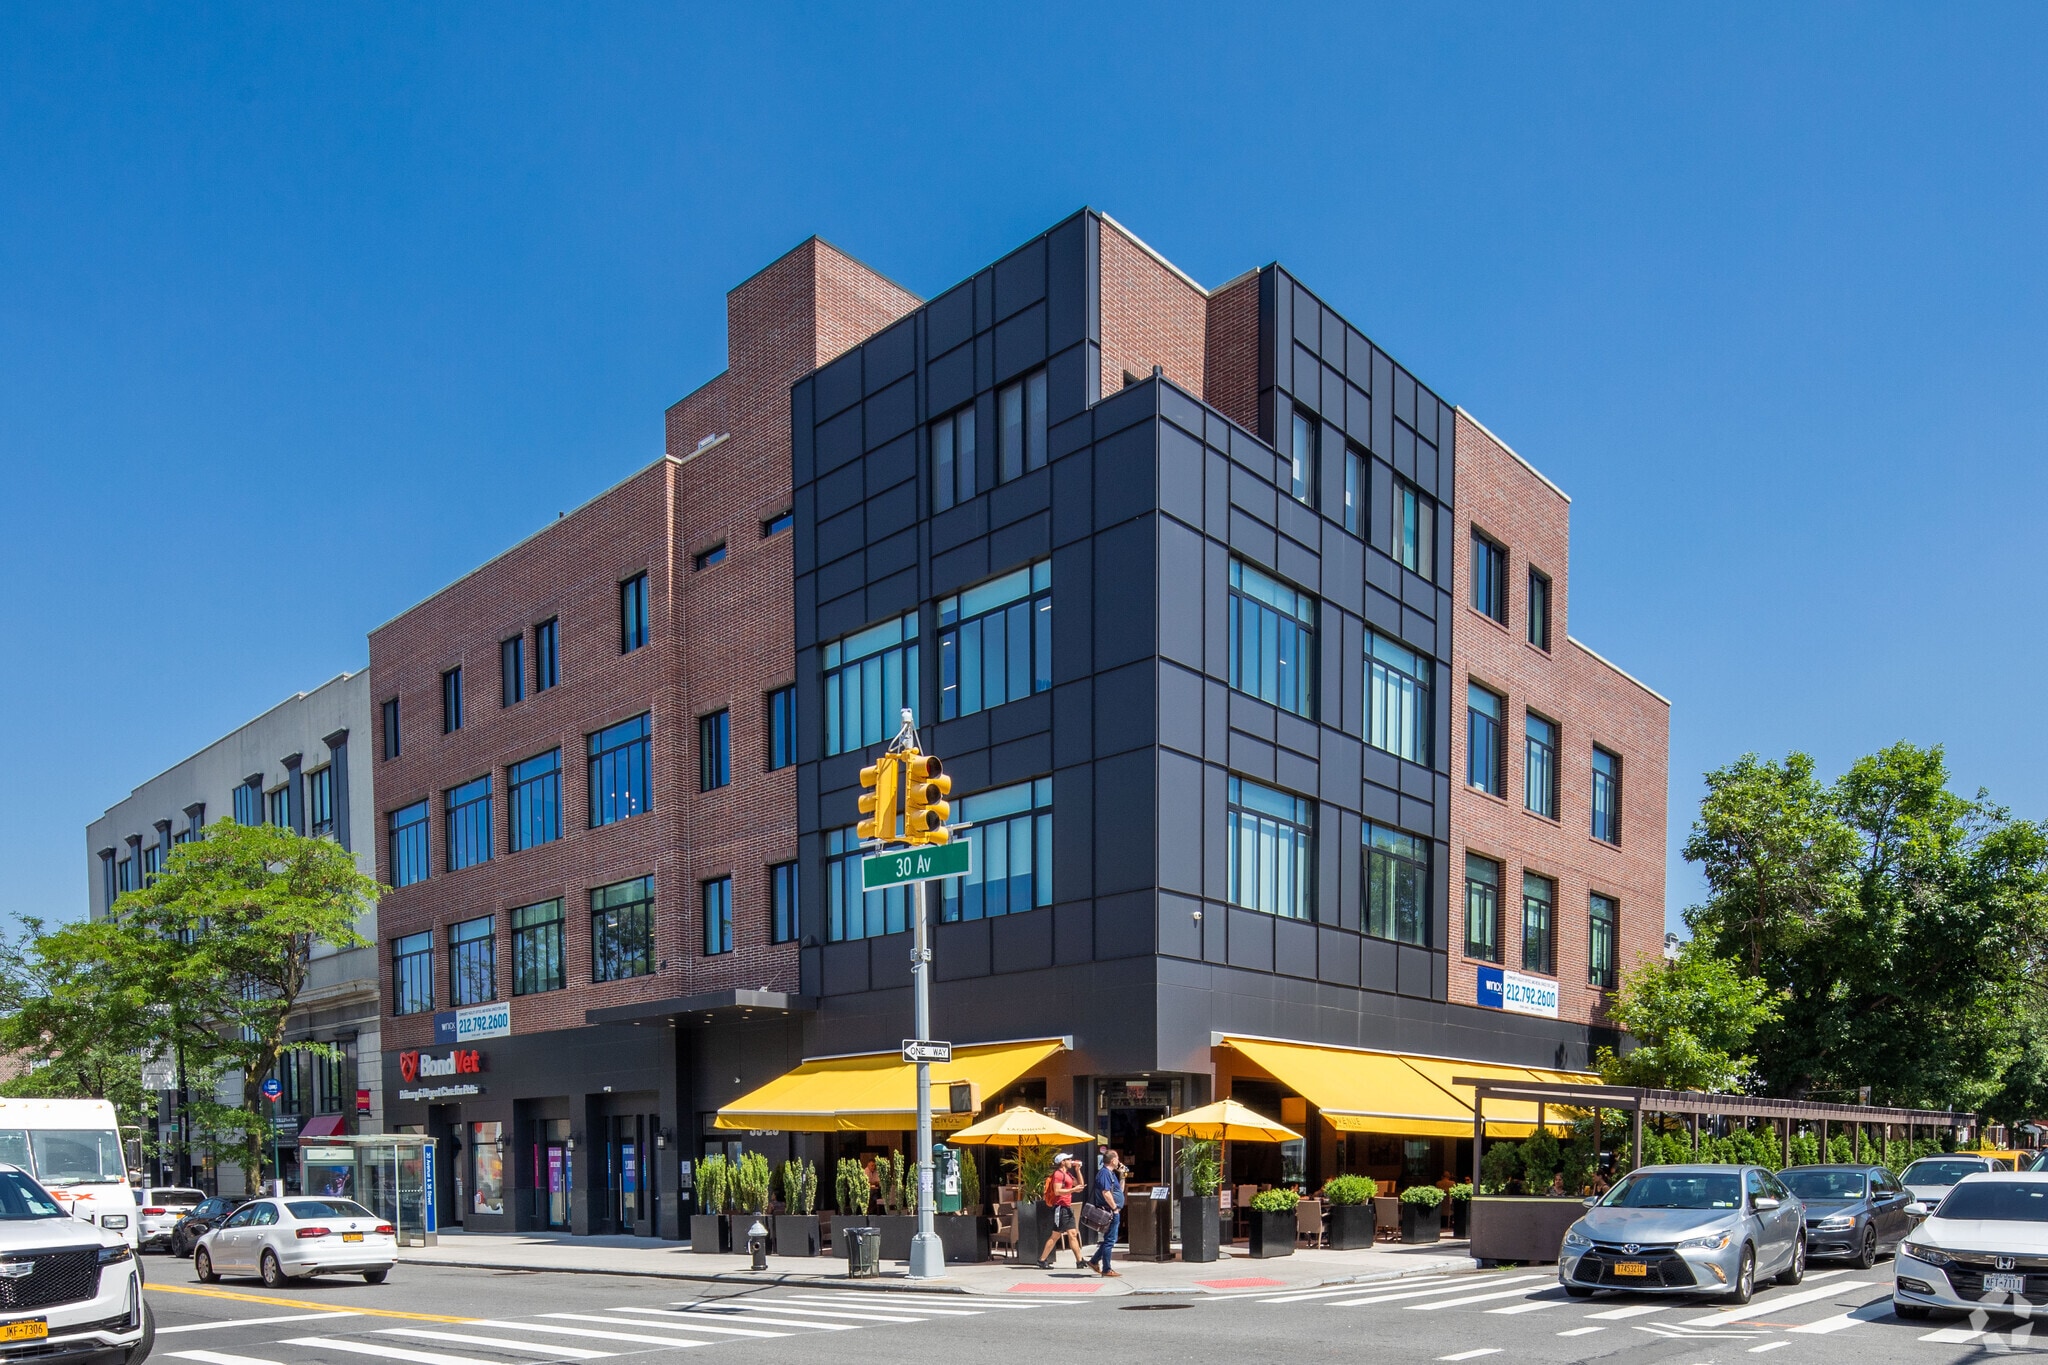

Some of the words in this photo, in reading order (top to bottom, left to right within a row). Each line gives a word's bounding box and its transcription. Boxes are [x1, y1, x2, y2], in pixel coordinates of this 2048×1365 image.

[896, 857, 912, 877] 30
[916, 855, 931, 874] Av
[1506, 983, 1556, 1008] 212.792.2600
[459, 1013, 508, 1034] 212.792.2600
[910, 1047, 926, 1056] ONE
[933, 1048, 947, 1056] WAY
[420, 1051, 456, 1077] Bond
[454, 1049, 479, 1074] Vet
[24, 1324, 43, 1335] 7306
